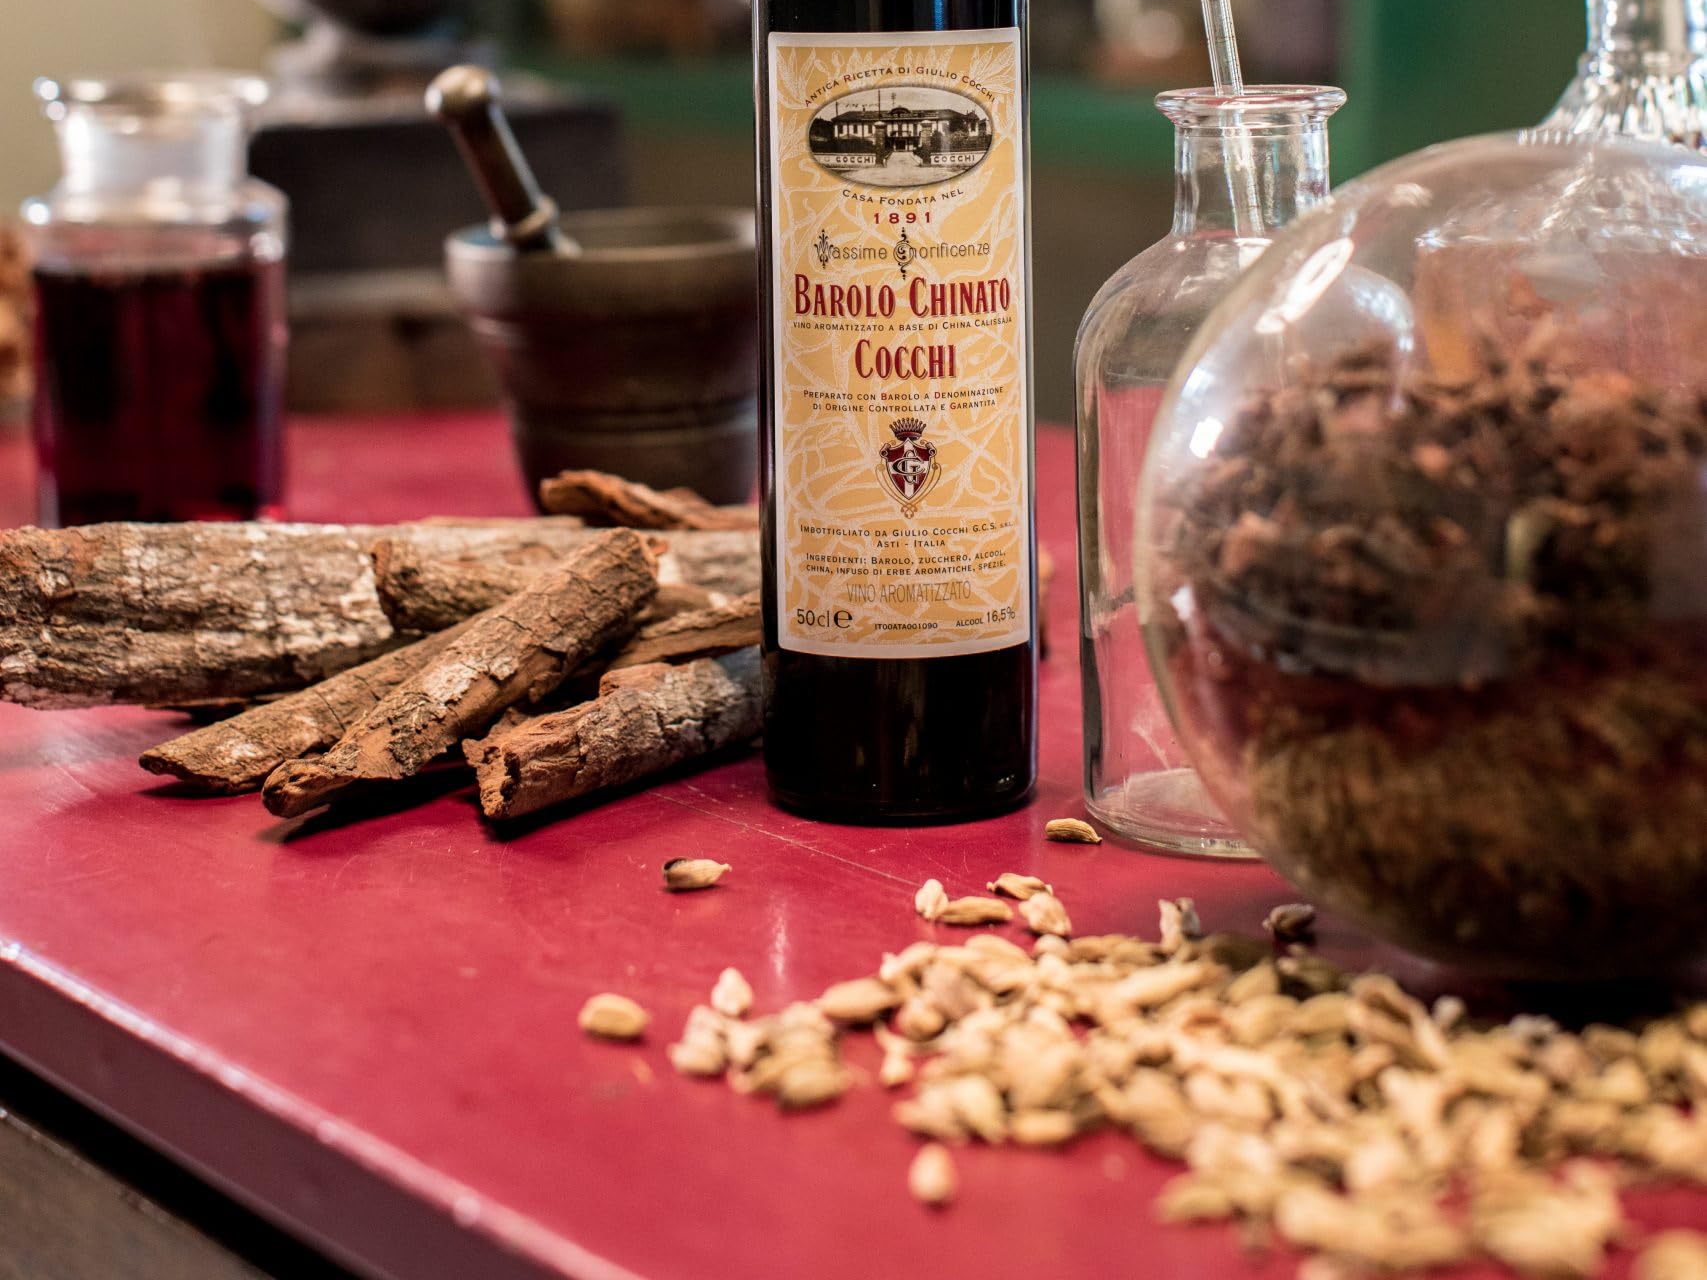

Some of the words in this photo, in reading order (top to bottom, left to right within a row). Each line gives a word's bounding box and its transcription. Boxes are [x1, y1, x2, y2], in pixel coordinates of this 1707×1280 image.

[805, 80, 840, 107] ANTICA
[843, 67, 893, 83] RICETTA
[916, 66, 958, 80] GIULIO
[961, 75, 996, 103] COCCHI
[933, 154, 976, 163] COCCHI
[842, 189, 874, 203] CASA
[879, 195, 937, 206] FONDATA
[941, 188, 964, 201] NEL
[873, 211, 931, 225] 1891
[794, 273, 896, 318] BAROLO
[909, 276, 1011, 318] CHINATO
[793, 321, 811, 330] VINO
[814, 323, 884, 332] AROMATIZZATO
[888, 324, 895, 332] A
[899, 323, 923, 332] BASE
[928, 323, 938, 331] DI
[942, 320, 971, 330] CHINA
[854, 338, 957, 380] COCCHI
[803, 389, 853, 401] PREPARATO
[857, 393, 876, 401] CON
[880, 392, 920, 401] BAROLO
[934, 386, 1004, 400] DENOMINAZIONE
[825, 403, 864, 413] ORIGINE
[868, 403, 936, 413] CONTROLLATA
[940, 403, 946, 411] E
[949, 398, 996, 411] GARANTITA
[800, 524, 870, 537] IMBOTTIGLIATO
[874, 529, 888, 537] DA
[892, 528, 928, 537] GIULIO
[932, 522, 968, 536] COCCHI
[972, 521, 997, 533] G.C.S.
[876, 539, 900, 549] ASTI
[914, 539, 946, 548] ITALIA
[806, 552, 867, 565] INGREDIENTI:
[871, 556, 915, 566] BAROLO,
[918, 553, 972, 565] ZUCCHERO,
[974, 549, 1006, 561] ALCOOL,
[806, 564, 834, 574] CHINA,
[836, 567, 870, 576] INFUSO
[872, 568, 883, 576] DI
[886, 568, 911, 576] ERBE
[914, 564, 976, 576] AROMATICHE,
[846, 584, 876, 603] VINO
[879, 580, 972, 603] AROMATIZZATO
[955, 618, 984, 628] ALCOOL
[985, 606, 1016, 625] 16,5%
